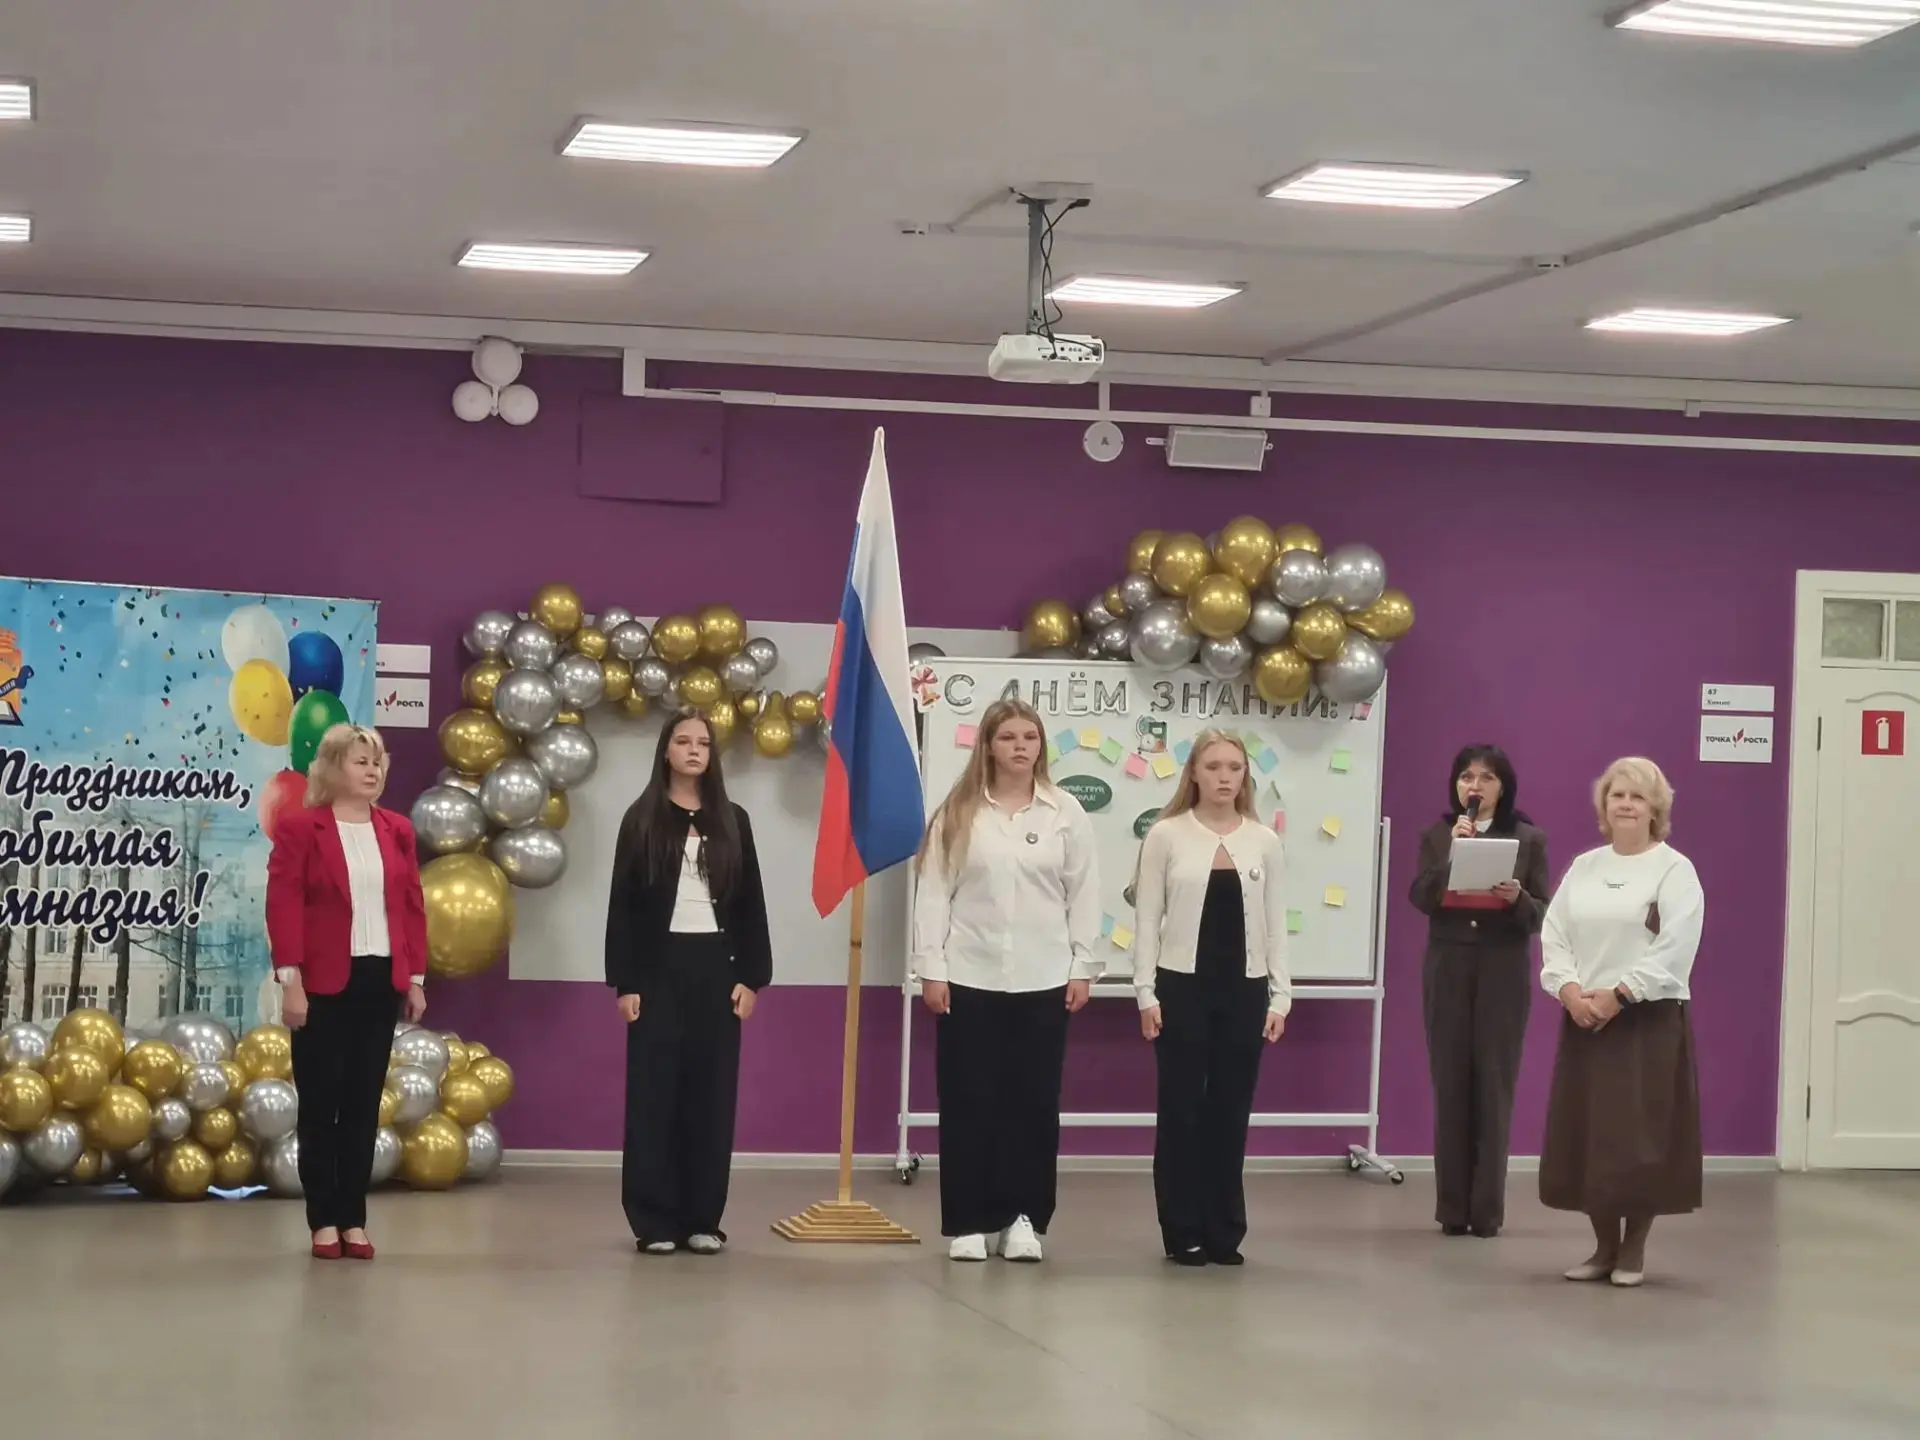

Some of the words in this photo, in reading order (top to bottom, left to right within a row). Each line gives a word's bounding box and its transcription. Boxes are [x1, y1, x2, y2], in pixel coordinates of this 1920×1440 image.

[396, 700, 424, 708] РОСТА
[944, 673, 975, 707] С
[0, 871, 210, 944] мназия!
